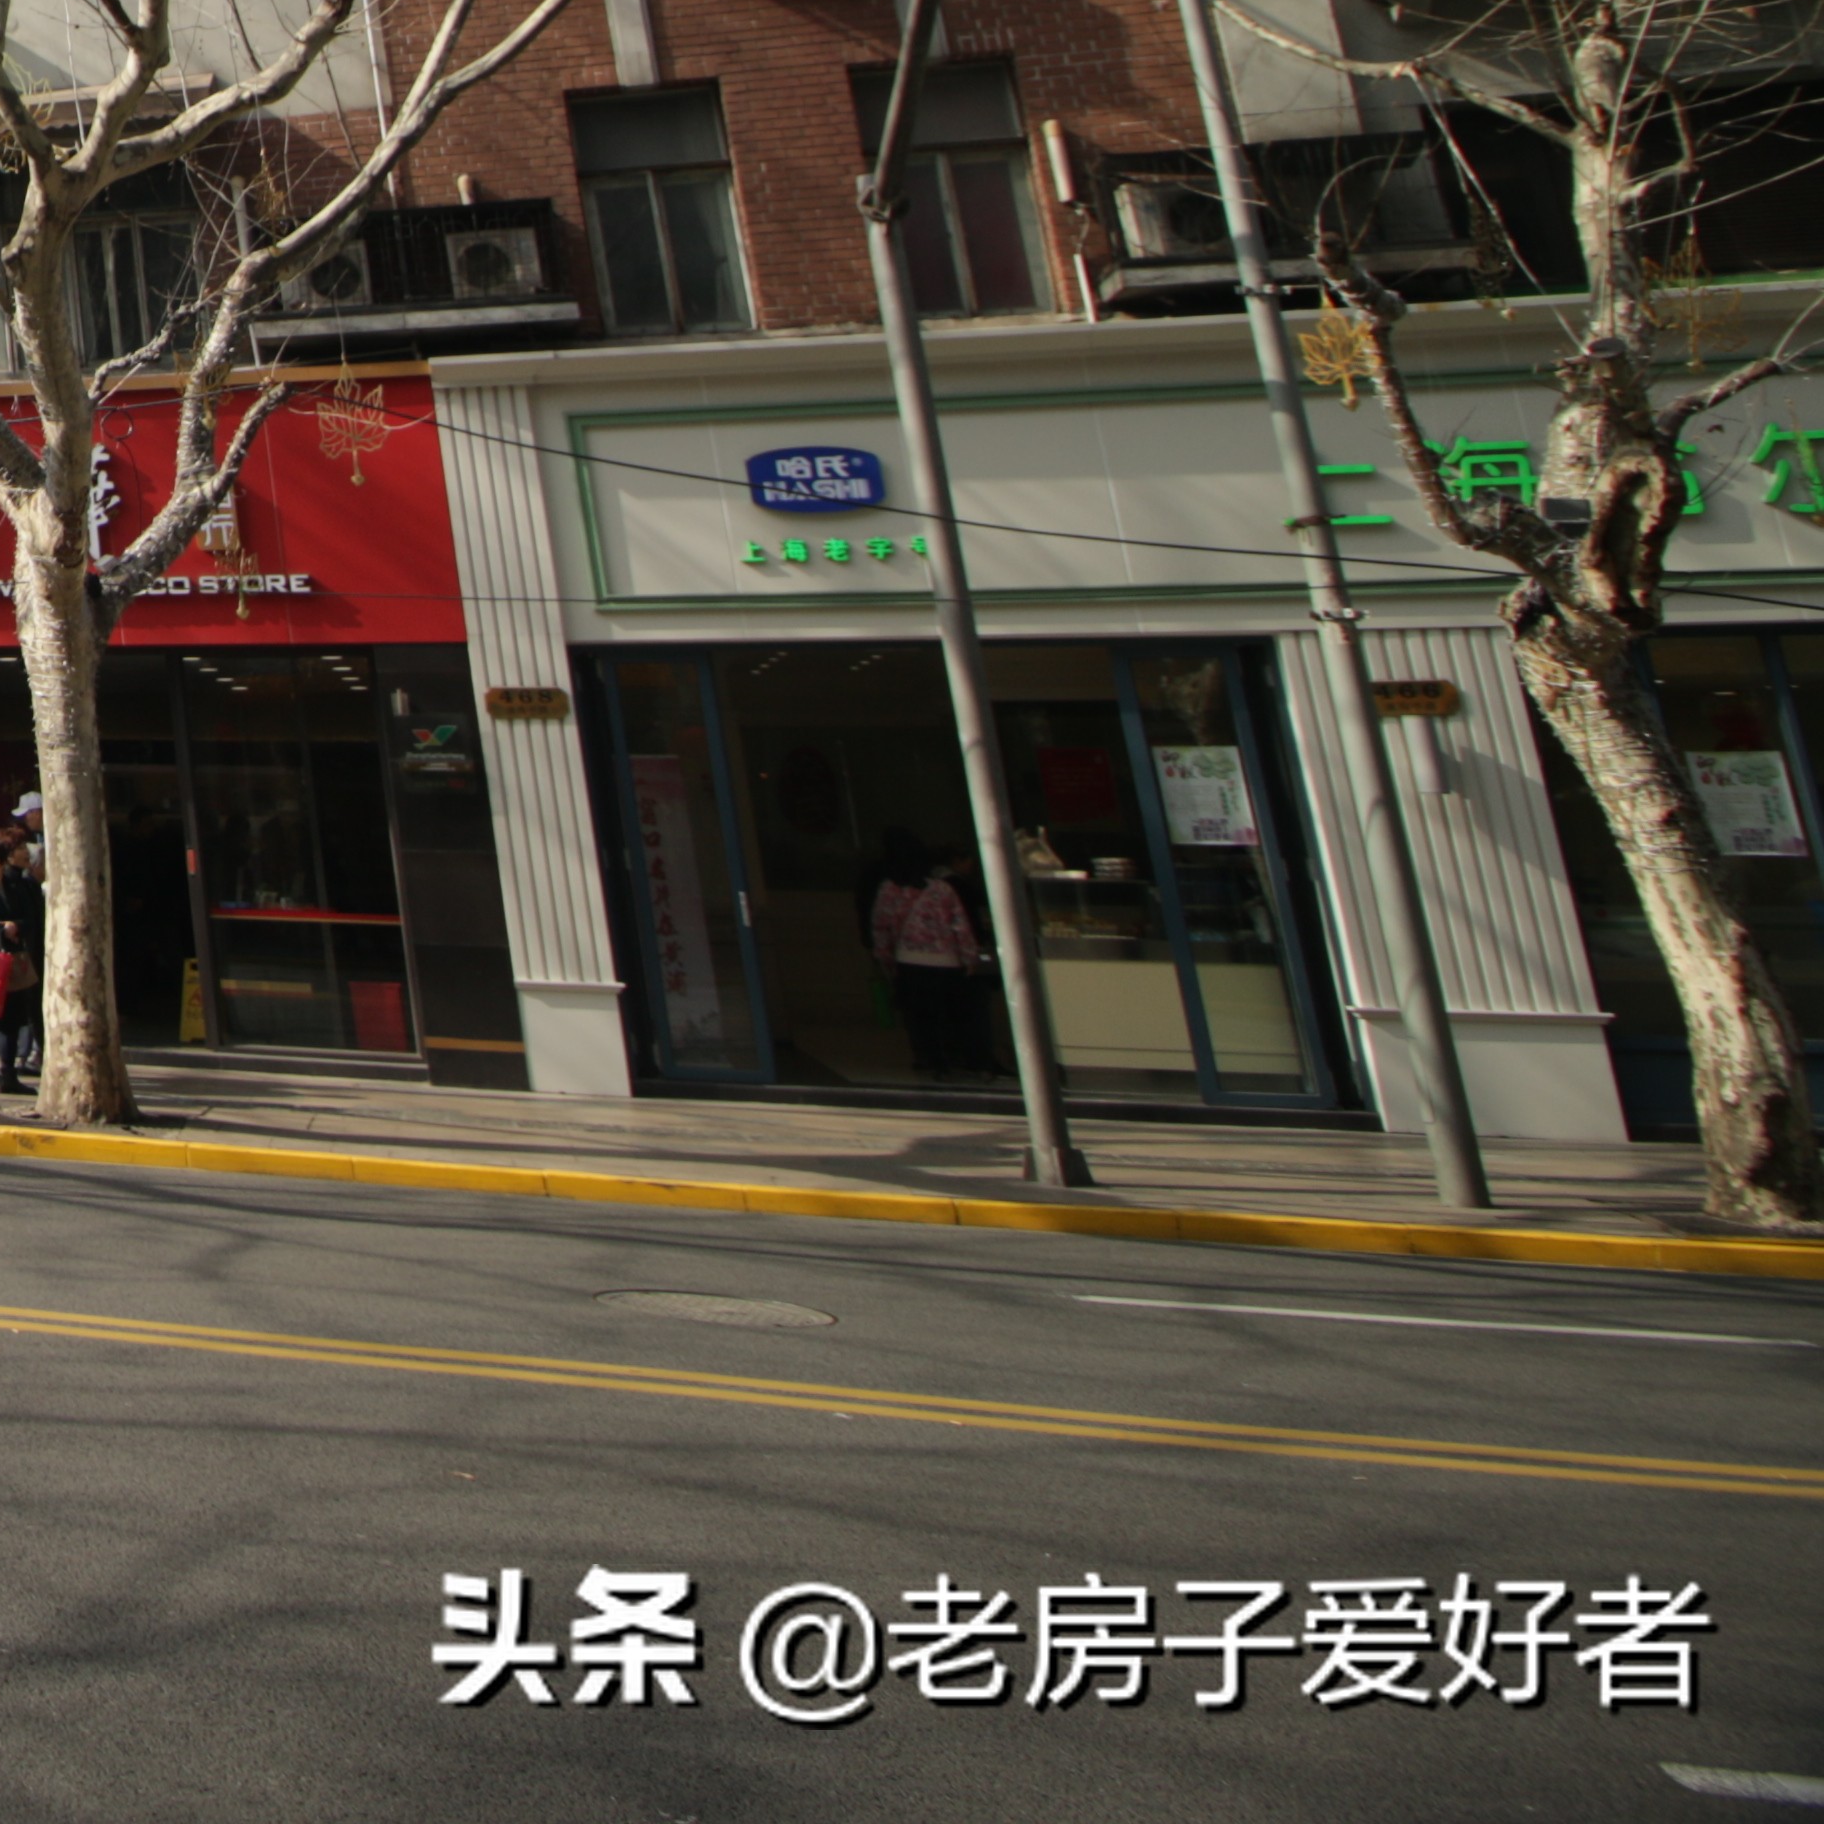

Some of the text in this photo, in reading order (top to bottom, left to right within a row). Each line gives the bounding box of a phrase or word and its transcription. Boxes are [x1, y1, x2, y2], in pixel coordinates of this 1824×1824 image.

[762, 478, 871, 502] HASHI
[198, 574, 311, 595] STORE
[500, 690, 553, 703] 468
